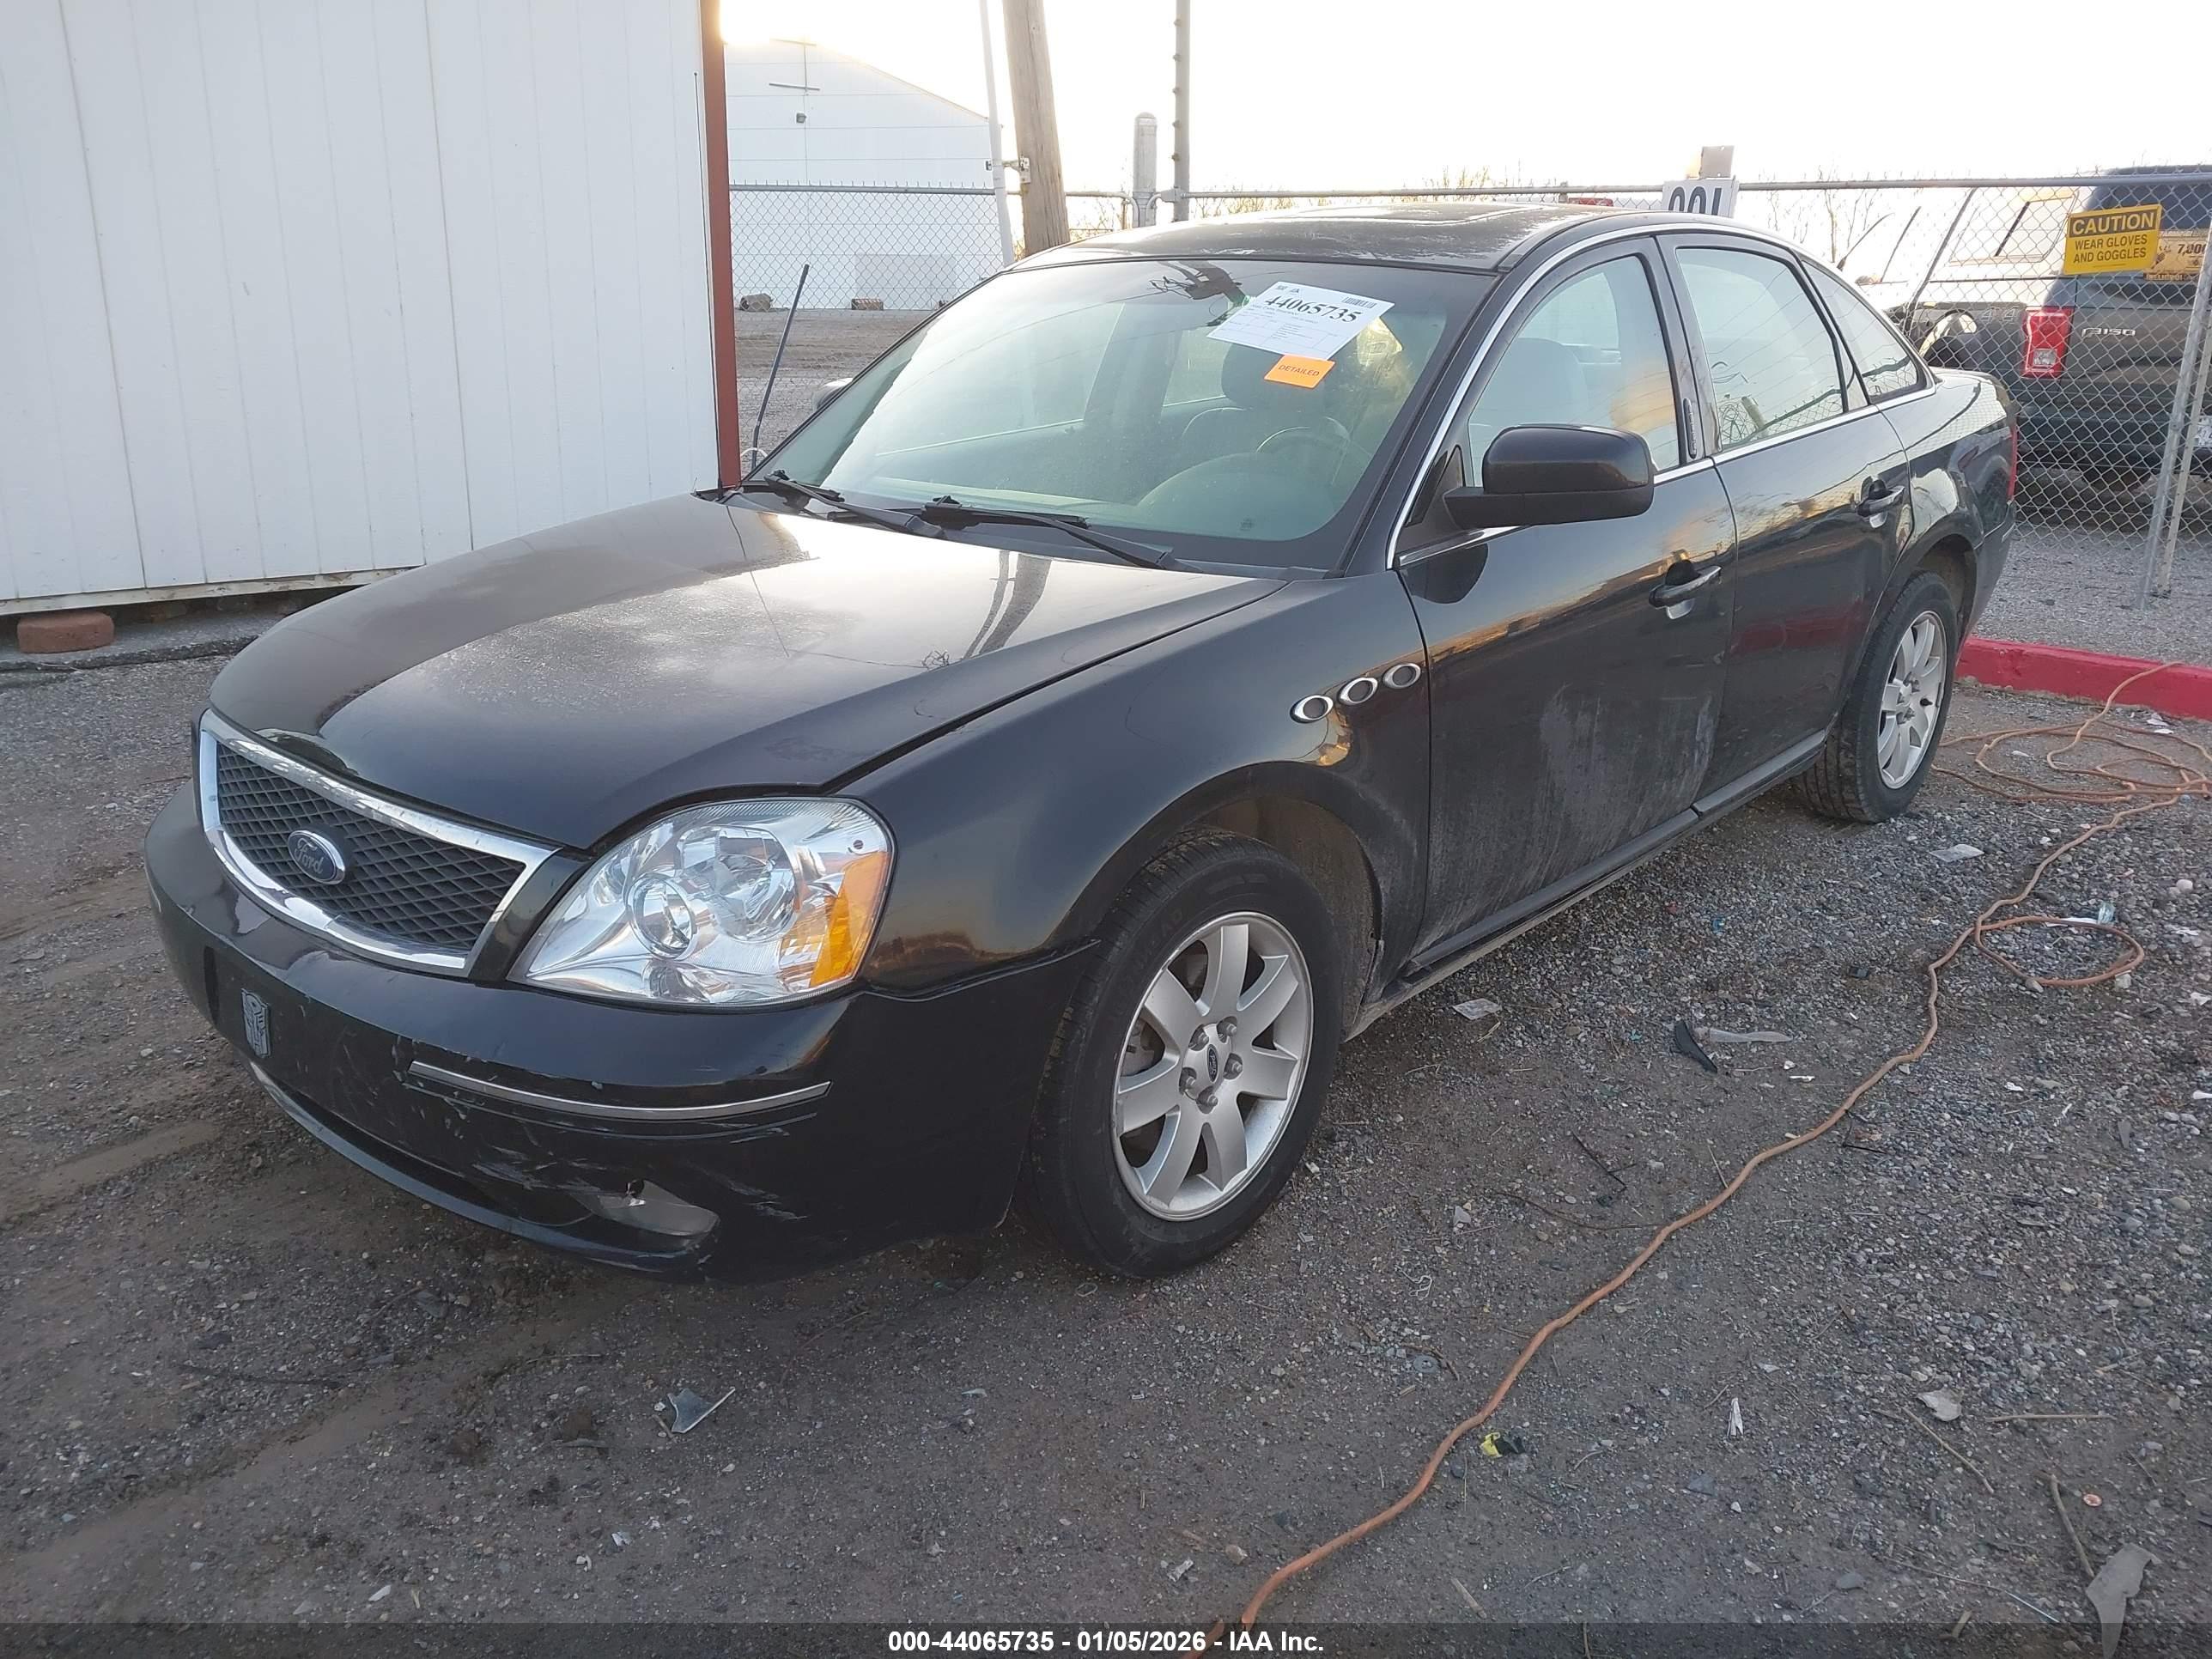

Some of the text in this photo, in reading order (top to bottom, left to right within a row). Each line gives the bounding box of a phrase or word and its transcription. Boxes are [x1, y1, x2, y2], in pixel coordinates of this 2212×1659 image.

[2072, 211, 2154, 235] CAUTION
[2075, 234, 2148, 251] WEAR GLOVES
[2073, 246, 2147, 264] AND GOGGLES
[1265, 295, 1364, 323] 44065735
[1278, 363, 1320, 377] DETAILED
[294, 837, 325, 874] Ford
